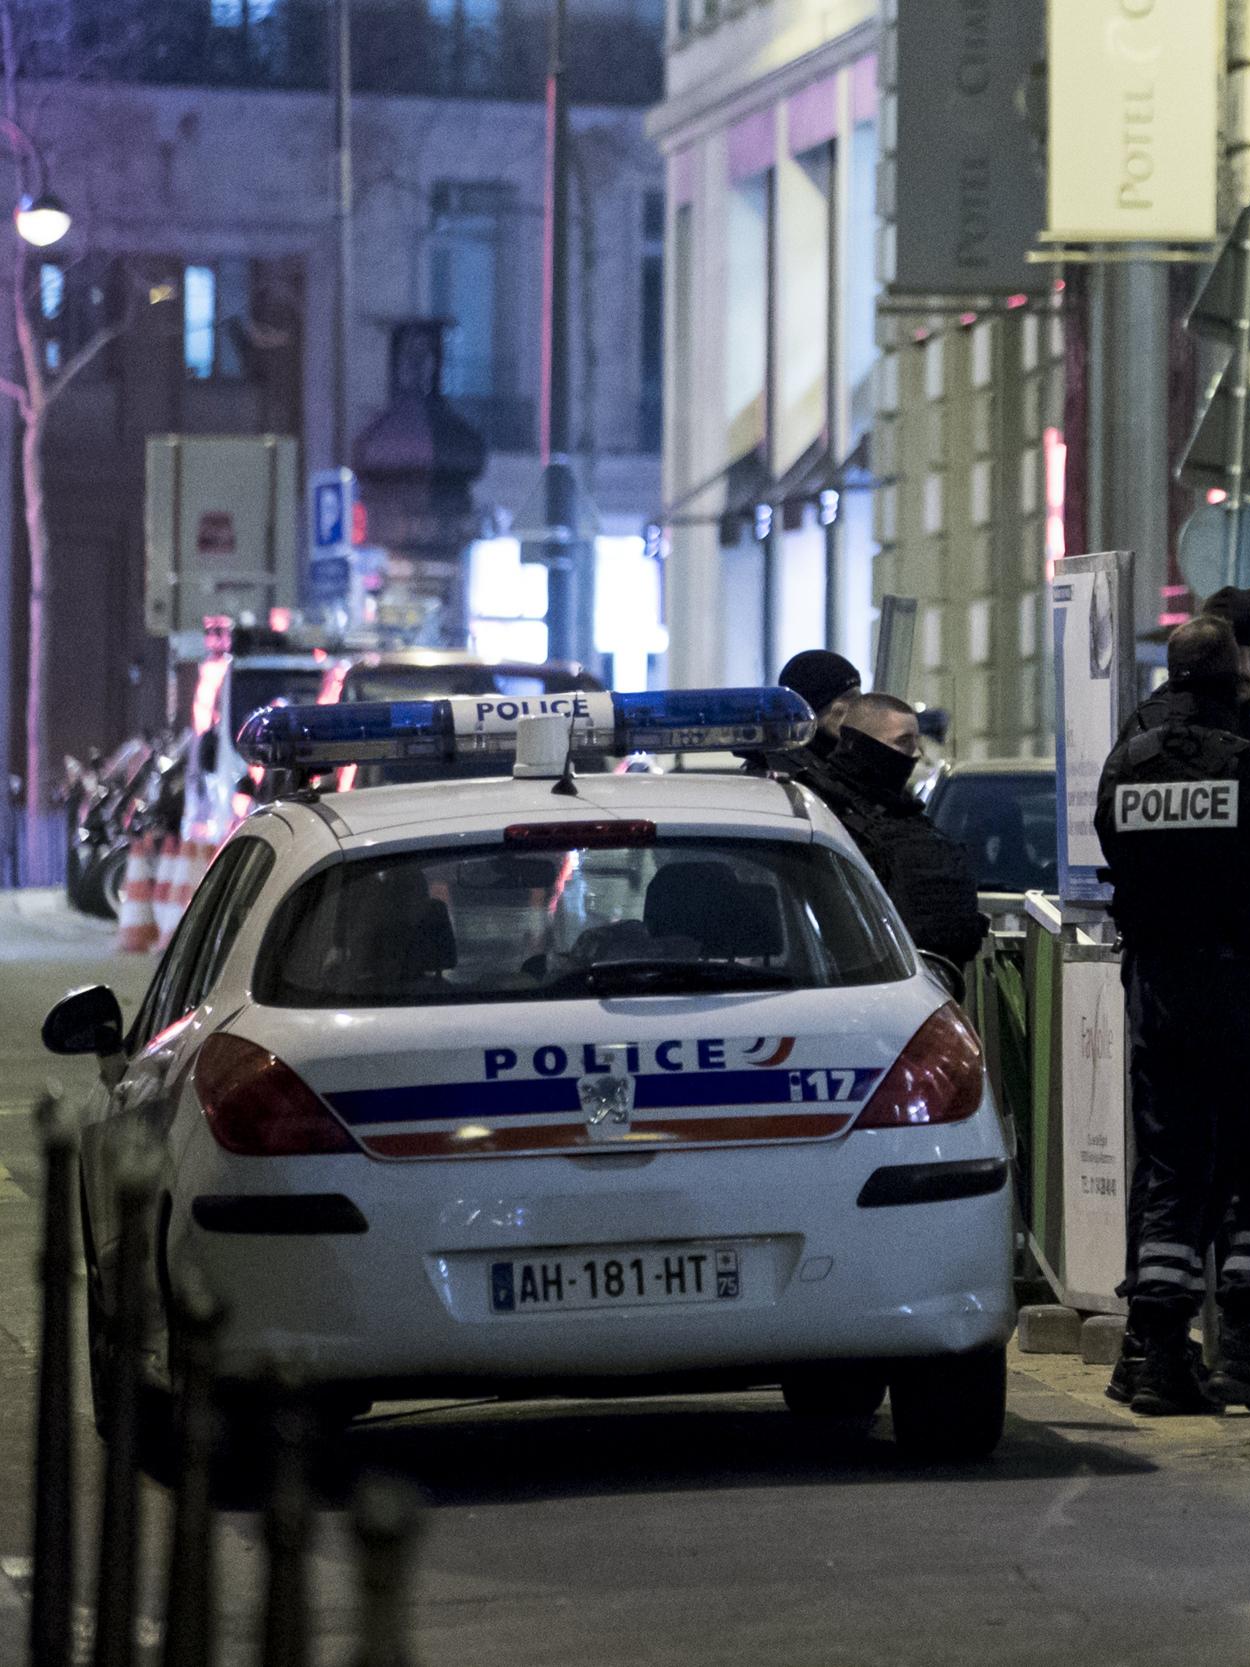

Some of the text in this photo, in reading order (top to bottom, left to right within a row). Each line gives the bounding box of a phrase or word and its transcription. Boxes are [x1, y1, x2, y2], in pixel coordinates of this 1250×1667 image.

[1117, 83, 1155, 209] POTEL
[476, 699, 590, 721] POLICE
[1121, 786, 1230, 824] POLICE
[484, 1038, 727, 1080] POLICE
[806, 1070, 856, 1101] 17
[520, 1255, 707, 1303] AH-181-HT
[718, 1277, 737, 1295] 75
